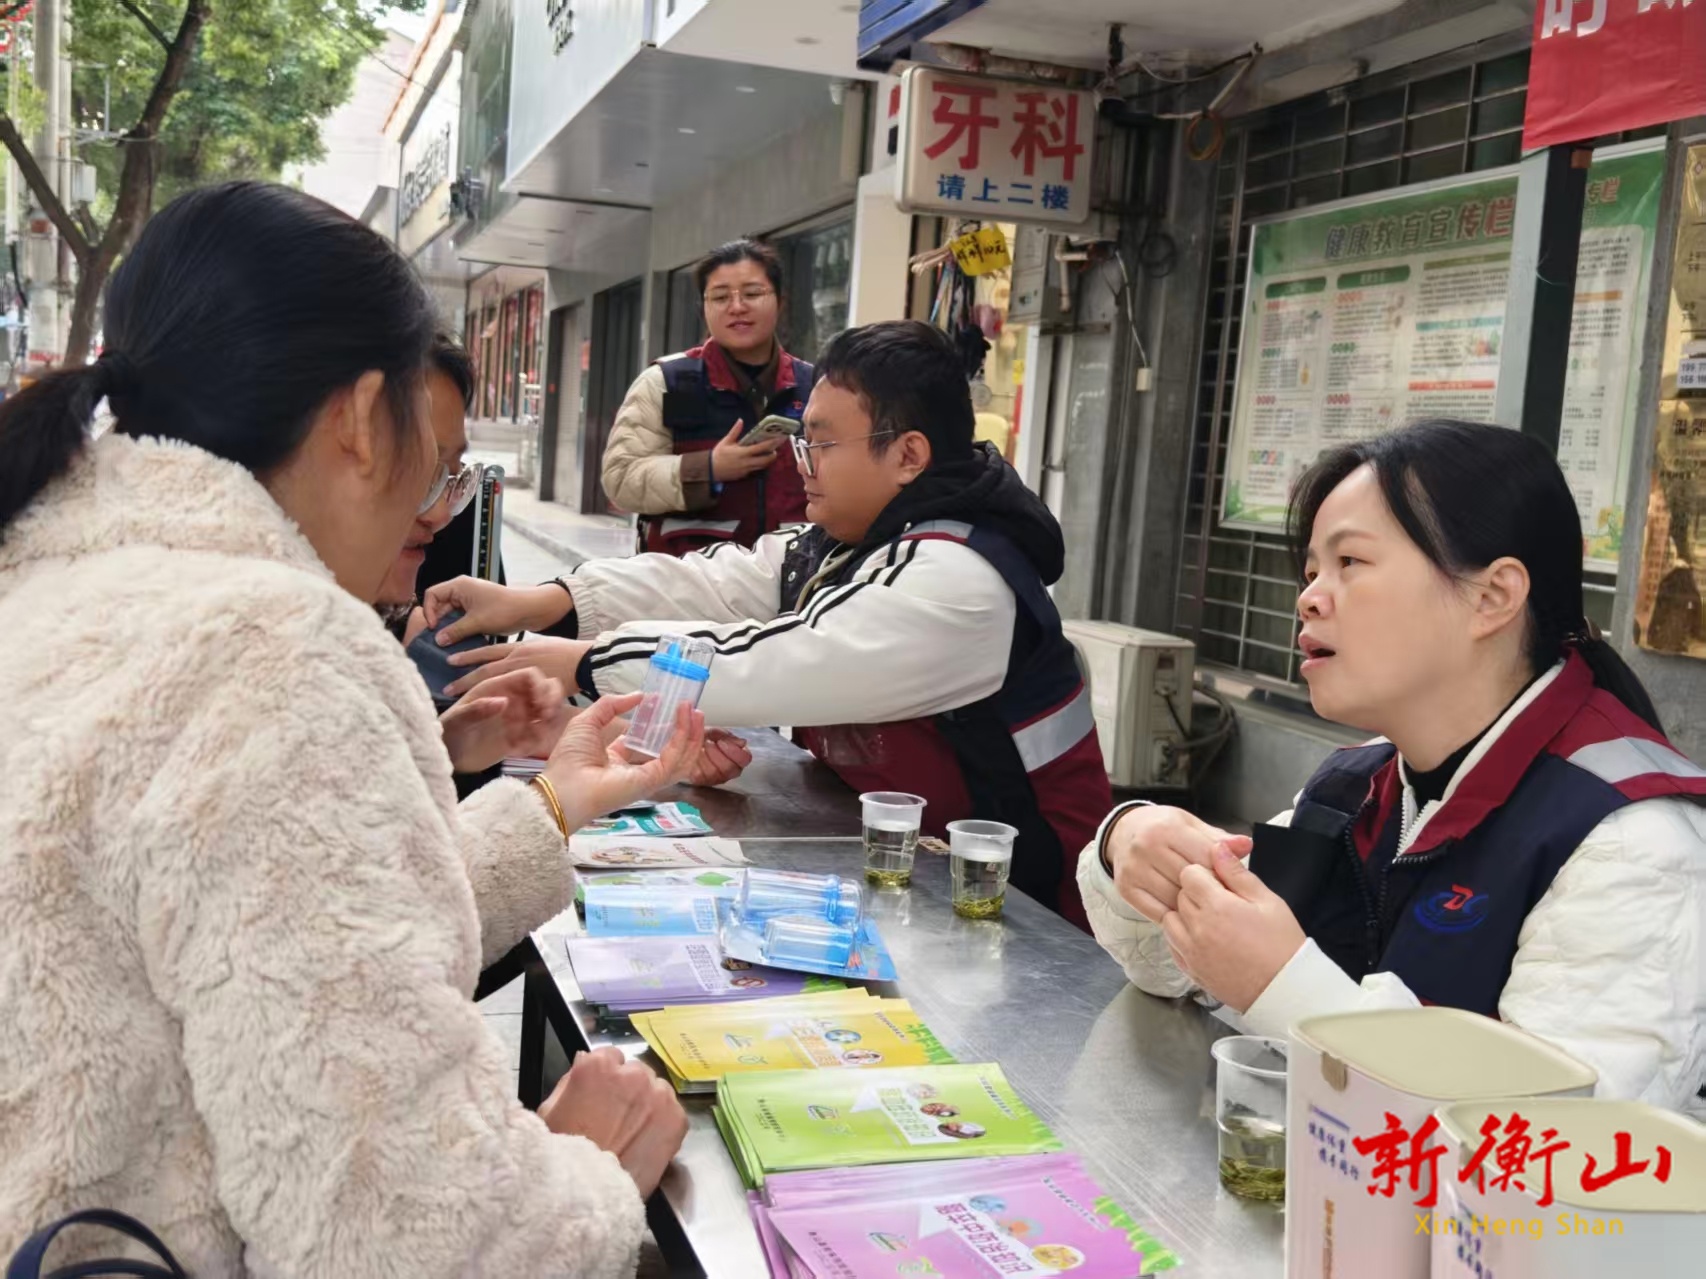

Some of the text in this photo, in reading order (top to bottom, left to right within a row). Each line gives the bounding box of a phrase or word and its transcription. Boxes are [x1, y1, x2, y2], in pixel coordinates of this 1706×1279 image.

[924, 81, 1084, 181] 牙科
[937, 174, 1069, 210] 请上二楼
[1324, 198, 1515, 260] 健康教育宣传栏
[934, 1202, 1034, 1275] 脑卒中防治知识
